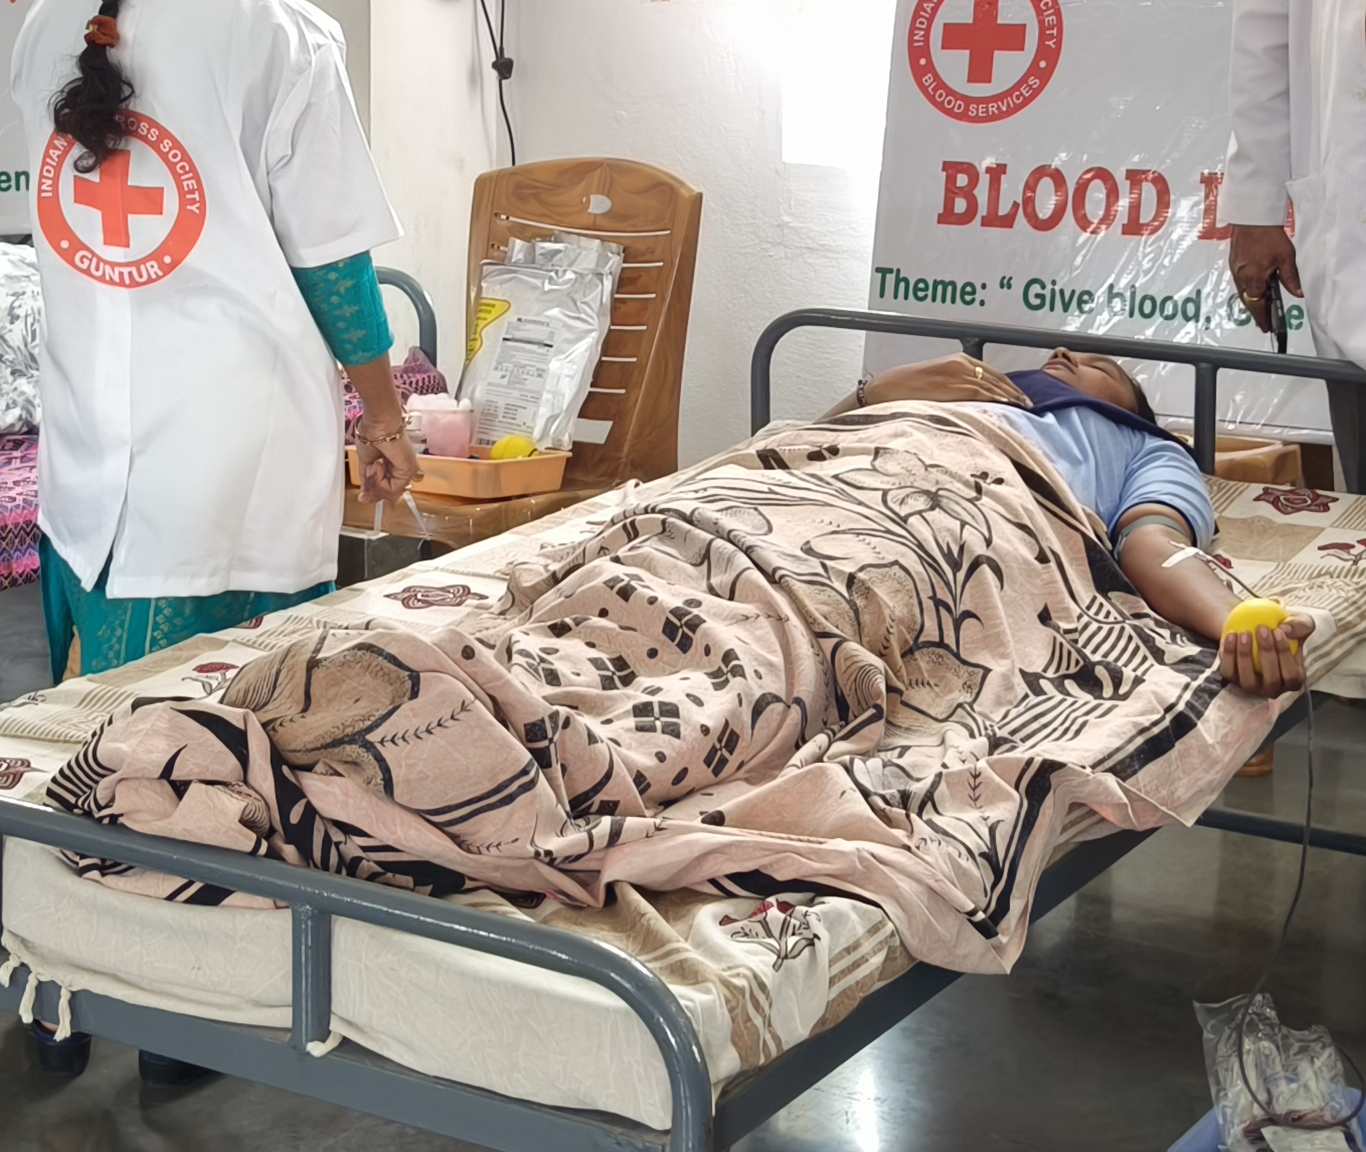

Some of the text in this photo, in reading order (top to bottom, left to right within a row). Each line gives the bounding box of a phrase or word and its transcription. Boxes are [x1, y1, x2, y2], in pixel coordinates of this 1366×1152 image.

[922, 73, 1040, 117] BLOOD SERVICES
[41, 135, 68, 197] INDIAN
[159, 138, 201, 215] SOCIETY
[937, 160, 1171, 237] BLOOD
[73, 249, 163, 285] GUNTUR
[874, 266, 988, 307] Theme:
[1022, 277, 1095, 318] Give
[1107, 283, 1212, 330] blood,
[1226, 293, 1305, 331] Ge
